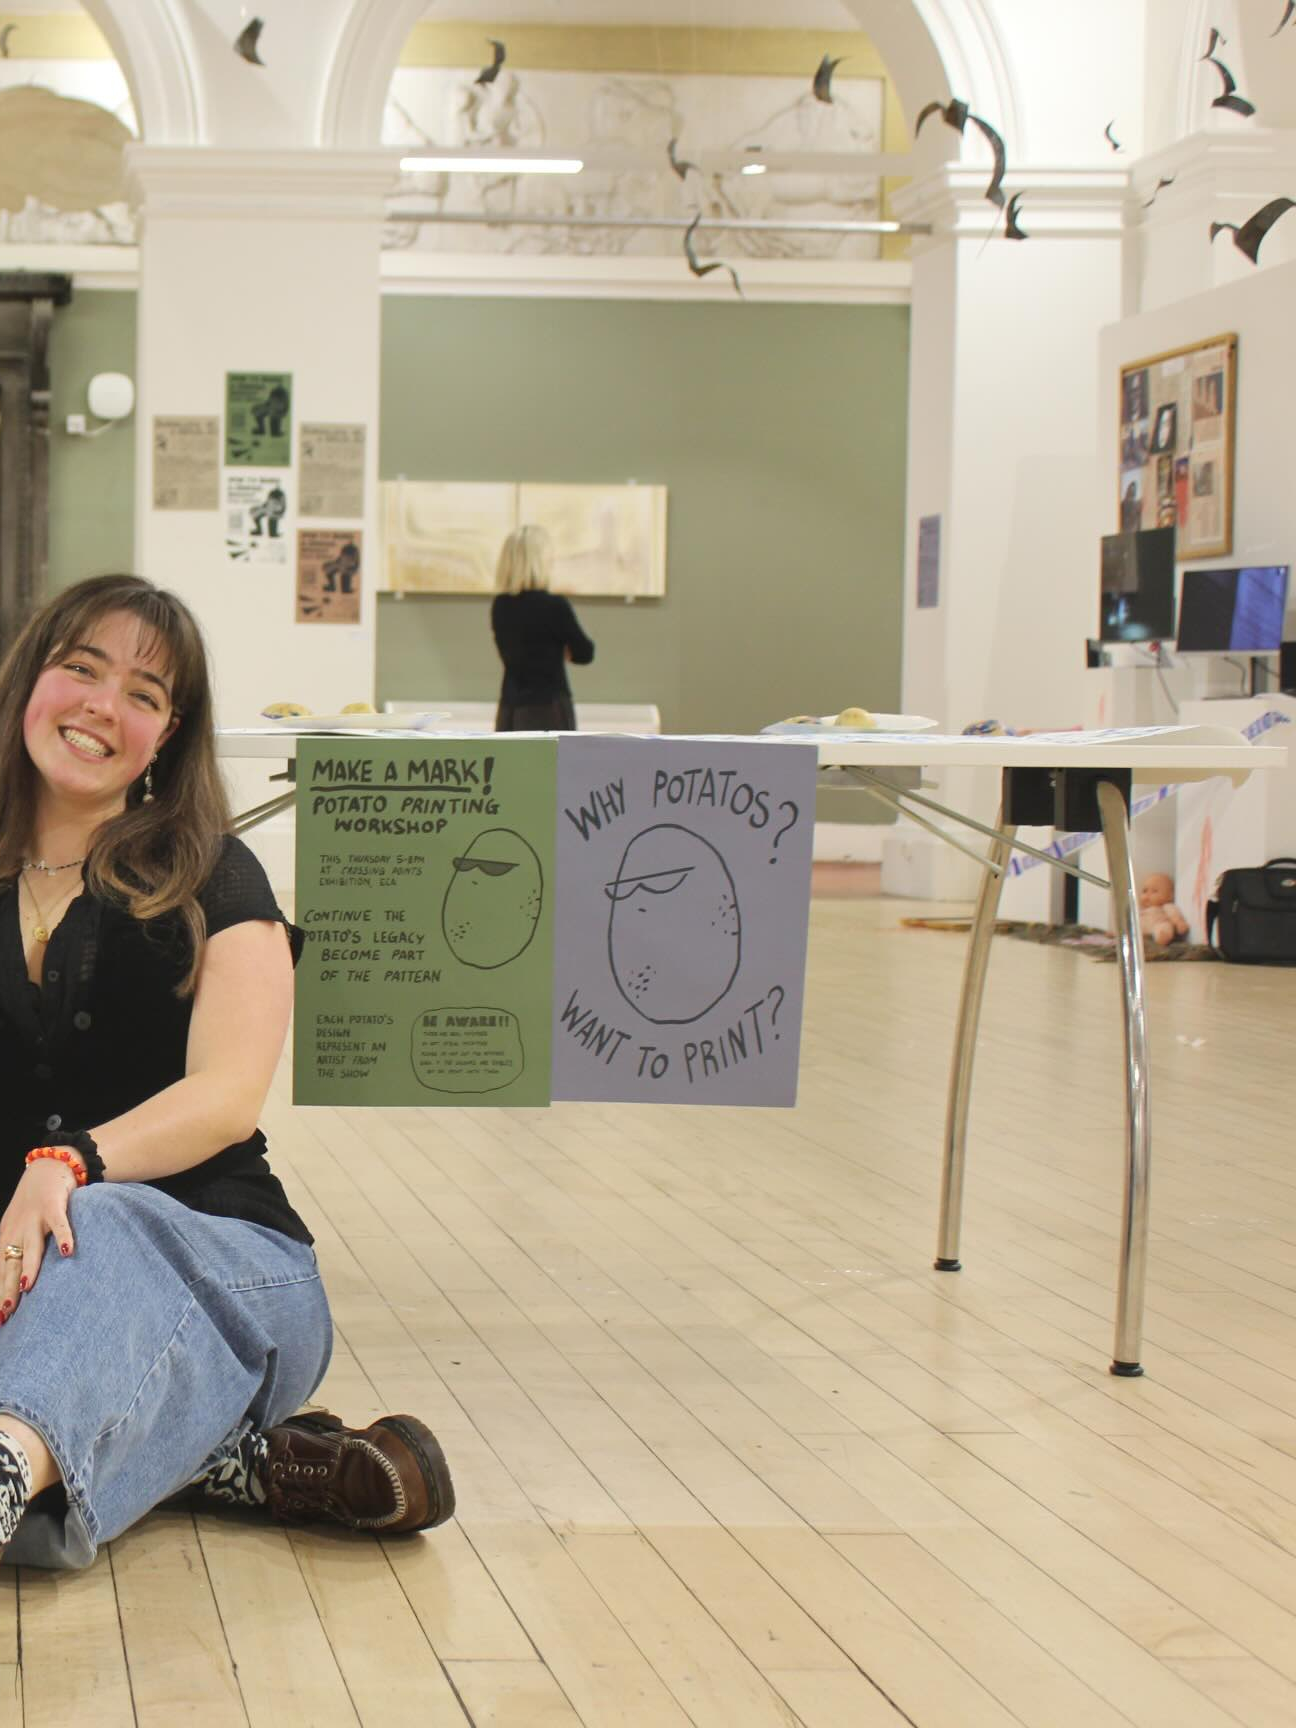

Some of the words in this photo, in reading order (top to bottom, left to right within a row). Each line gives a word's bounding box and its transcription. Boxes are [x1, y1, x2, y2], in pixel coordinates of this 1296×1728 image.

[312, 759, 373, 783] MAKE
[384, 760, 399, 783] A
[408, 757, 495, 796] MARK!
[312, 796, 388, 816] POTATO
[401, 798, 501, 816] PRINTING
[564, 777, 626, 842] WHY
[653, 767, 799, 864] POTATOS?
[334, 818, 449, 836] WORKSHOP
[319, 854, 341, 865] THIS
[348, 854, 392, 865] THURSDAY
[319, 866, 332, 876] AT
[304, 909, 373, 924] CONTINUE
[385, 909, 406, 923] THE
[302, 928, 362, 945] POTATO'S
[373, 930, 425, 945] LEGACY
[321, 948, 382, 962] BECOME
[391, 949, 425, 961] PART
[320, 970, 339, 982] OF
[347, 969, 371, 982] THE
[383, 969, 441, 983] PATTERN
[316, 1014, 344, 1025] EACH
[349, 1013, 394, 1025] POTATO'S
[560, 989, 632, 1065] WANT
[637, 1046, 669, 1079] TO
[684, 985, 785, 1083] PRINT?
[371, 1041, 386, 1052] AN
[316, 1055, 346, 1065] ARTIST
[317, 1068, 335, 1079] THE
[339, 1068, 370, 1079] SHOW
